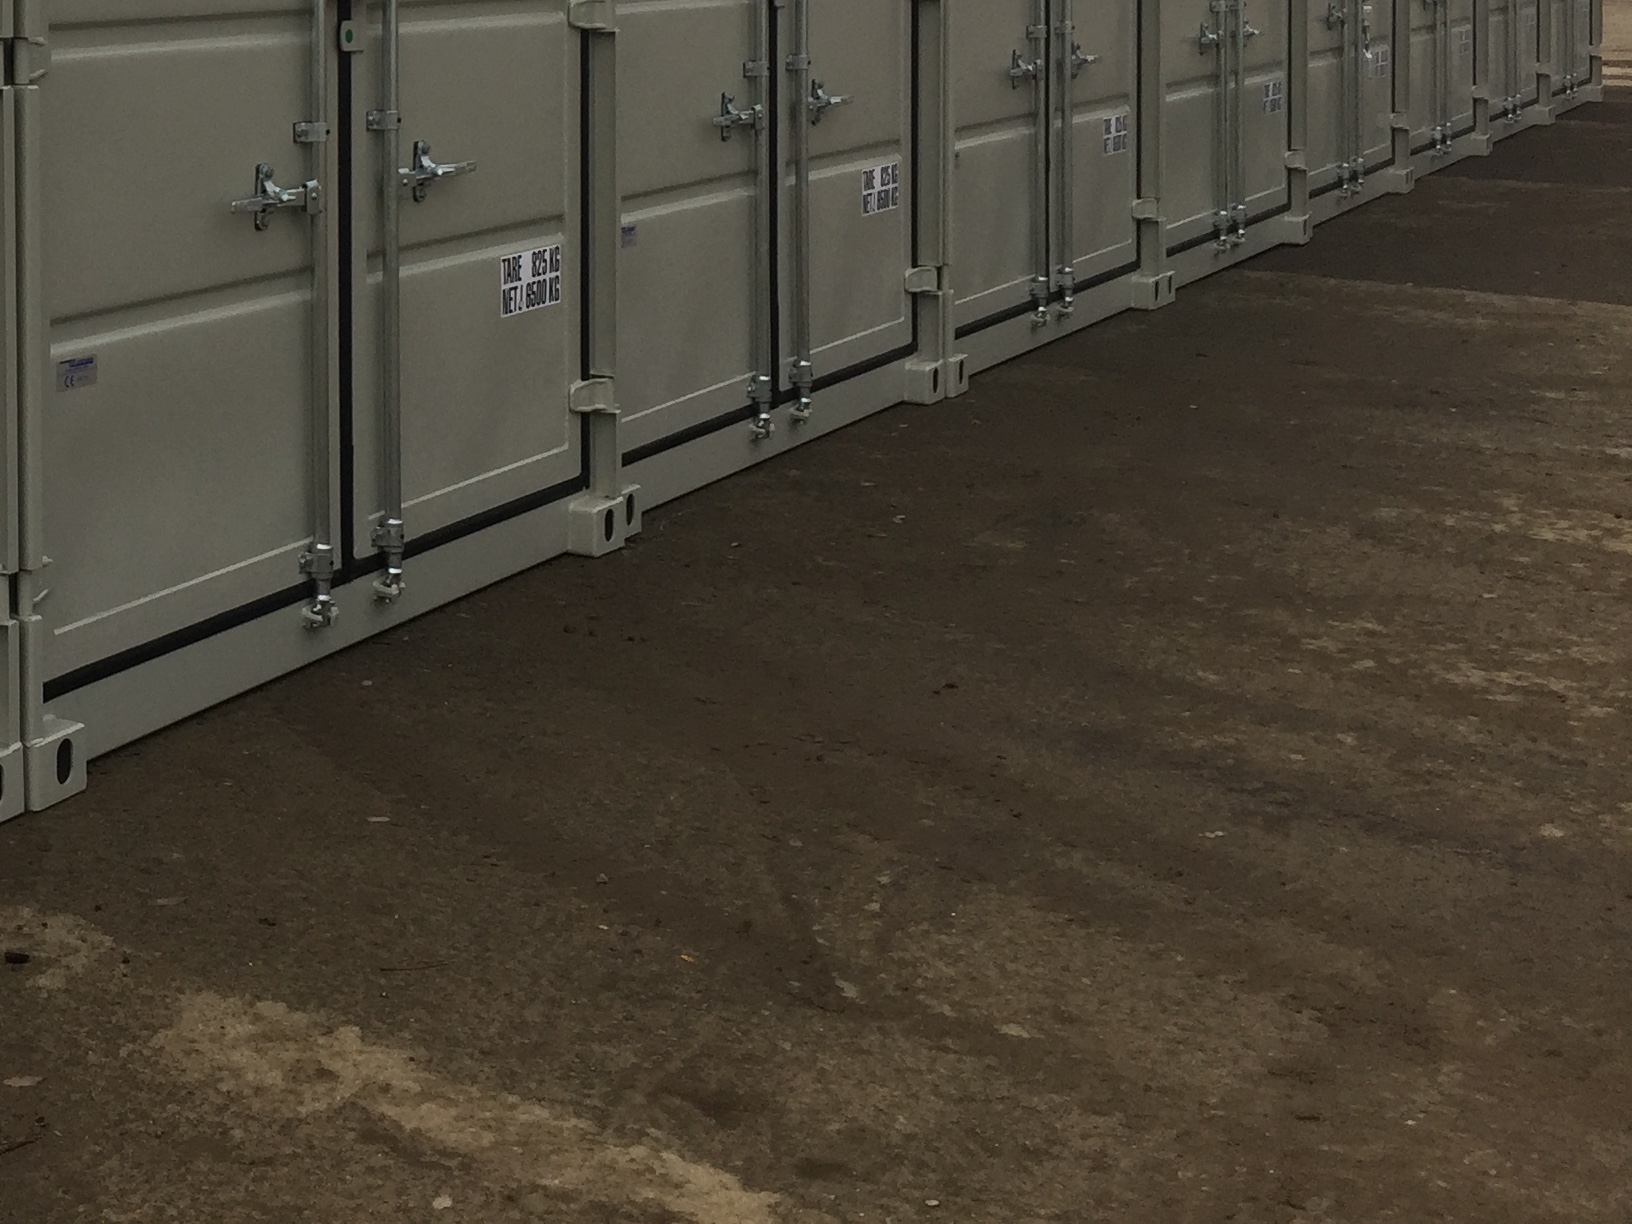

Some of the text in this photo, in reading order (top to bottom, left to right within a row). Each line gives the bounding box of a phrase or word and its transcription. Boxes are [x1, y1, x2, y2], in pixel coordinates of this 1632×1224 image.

[502, 245, 560, 285] TARE 825 KG
[502, 275, 560, 315] NET 6500 KG
